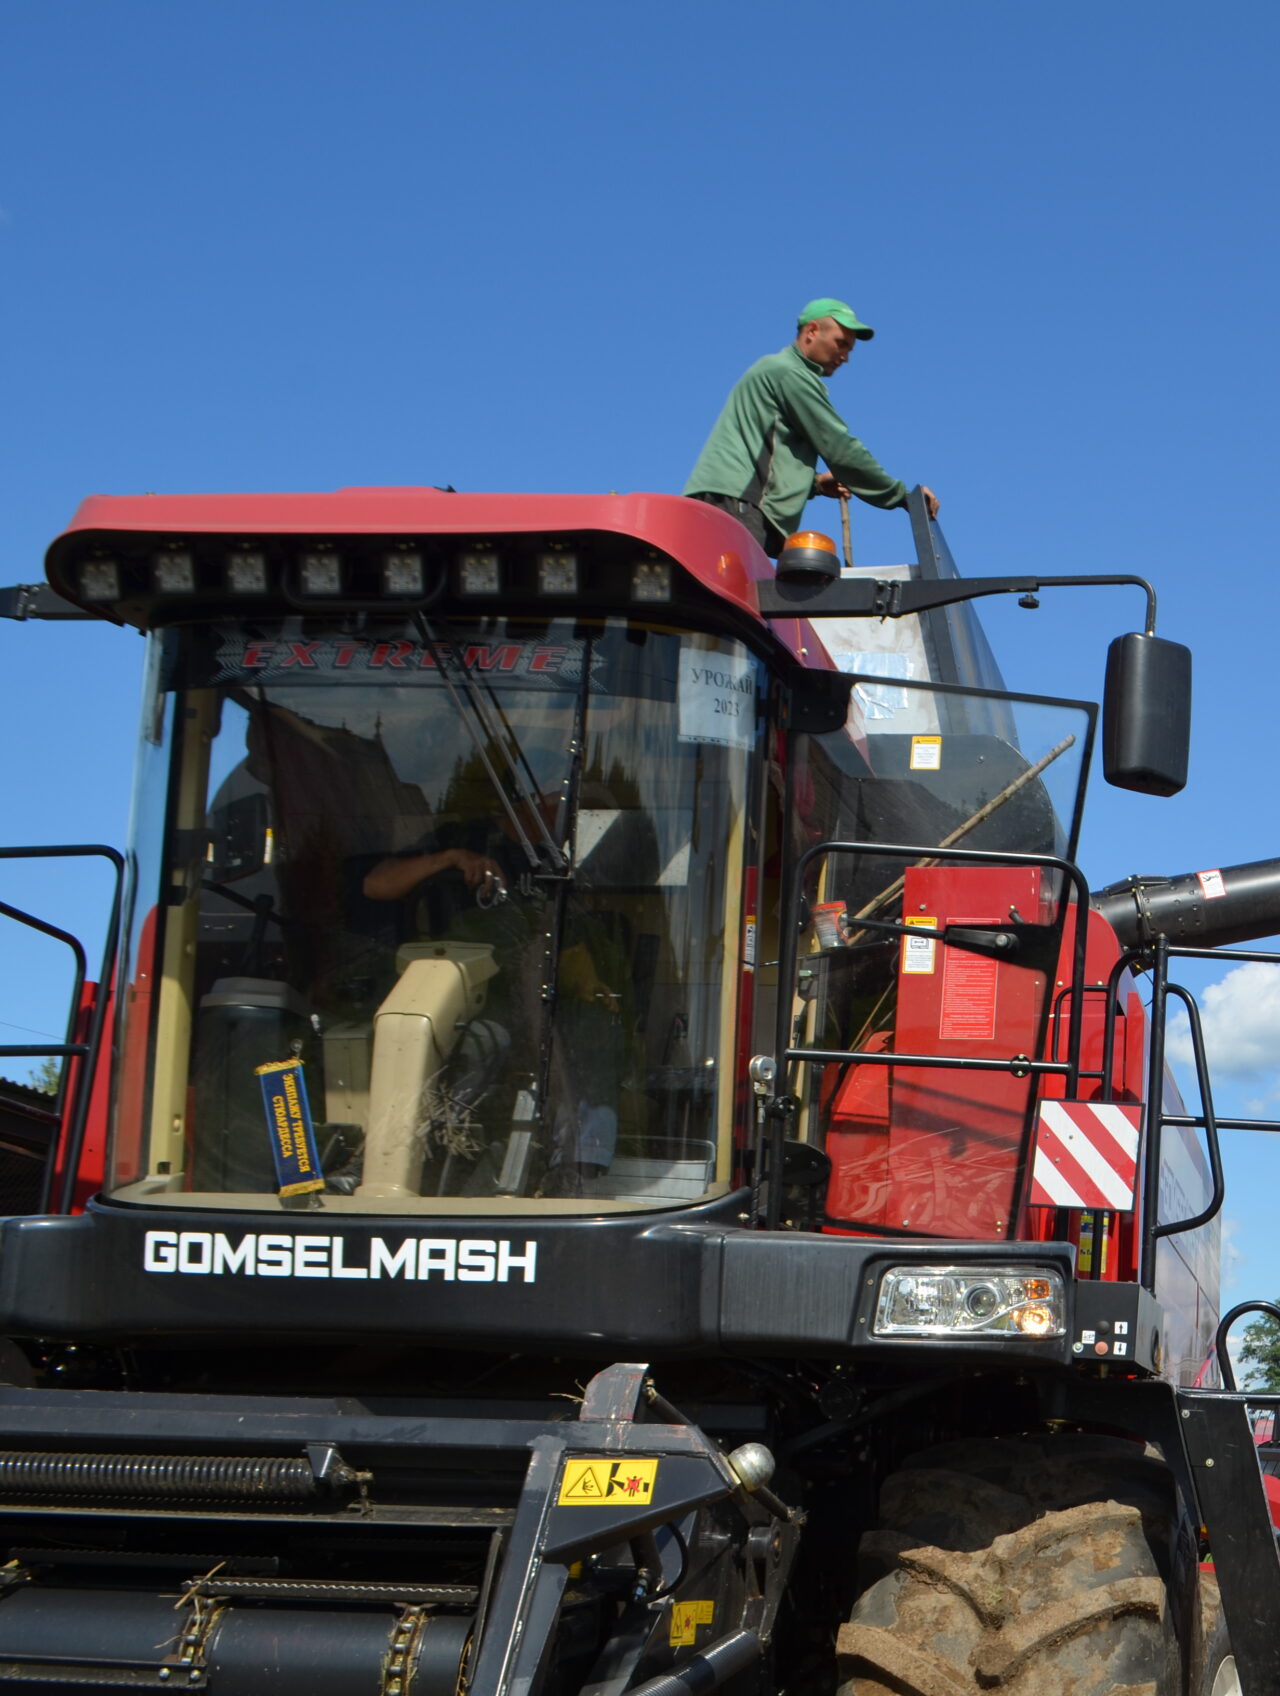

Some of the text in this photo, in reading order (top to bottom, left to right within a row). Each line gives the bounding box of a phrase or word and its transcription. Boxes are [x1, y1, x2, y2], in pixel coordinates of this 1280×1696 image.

[241, 641, 568, 673] EXTREME
[691, 668, 753, 695] УРОЖАЙ
[714, 698, 740, 717] 2023
[272, 1095, 293, 1158] СТЮАРДЕССА
[282, 1073, 311, 1173] ЭКИПАЖУ ТРЕБУЕТСЯ
[144, 1231, 538, 1283] GOMSELMASH
